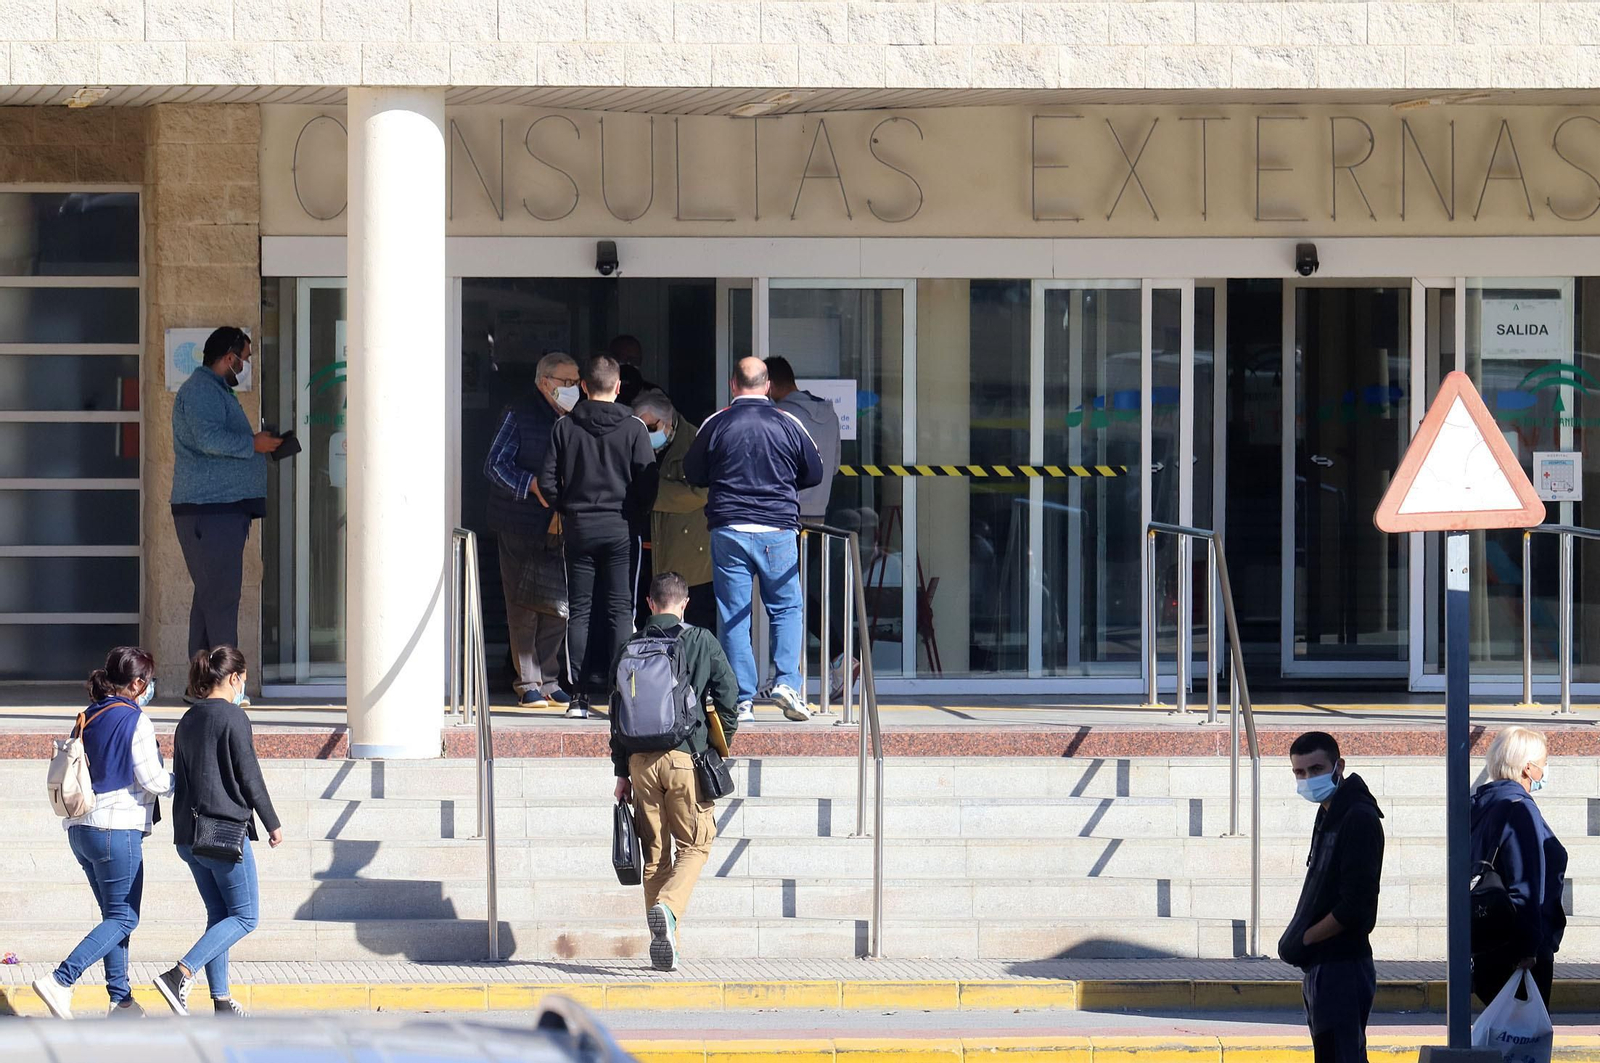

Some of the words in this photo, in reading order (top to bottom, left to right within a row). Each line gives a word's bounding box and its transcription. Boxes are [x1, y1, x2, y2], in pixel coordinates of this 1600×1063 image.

[294, 114, 923, 222] CNSULTAS
[1032, 114, 1600, 222] EXTERNAS
[1496, 324, 1549, 336] SALIDA
